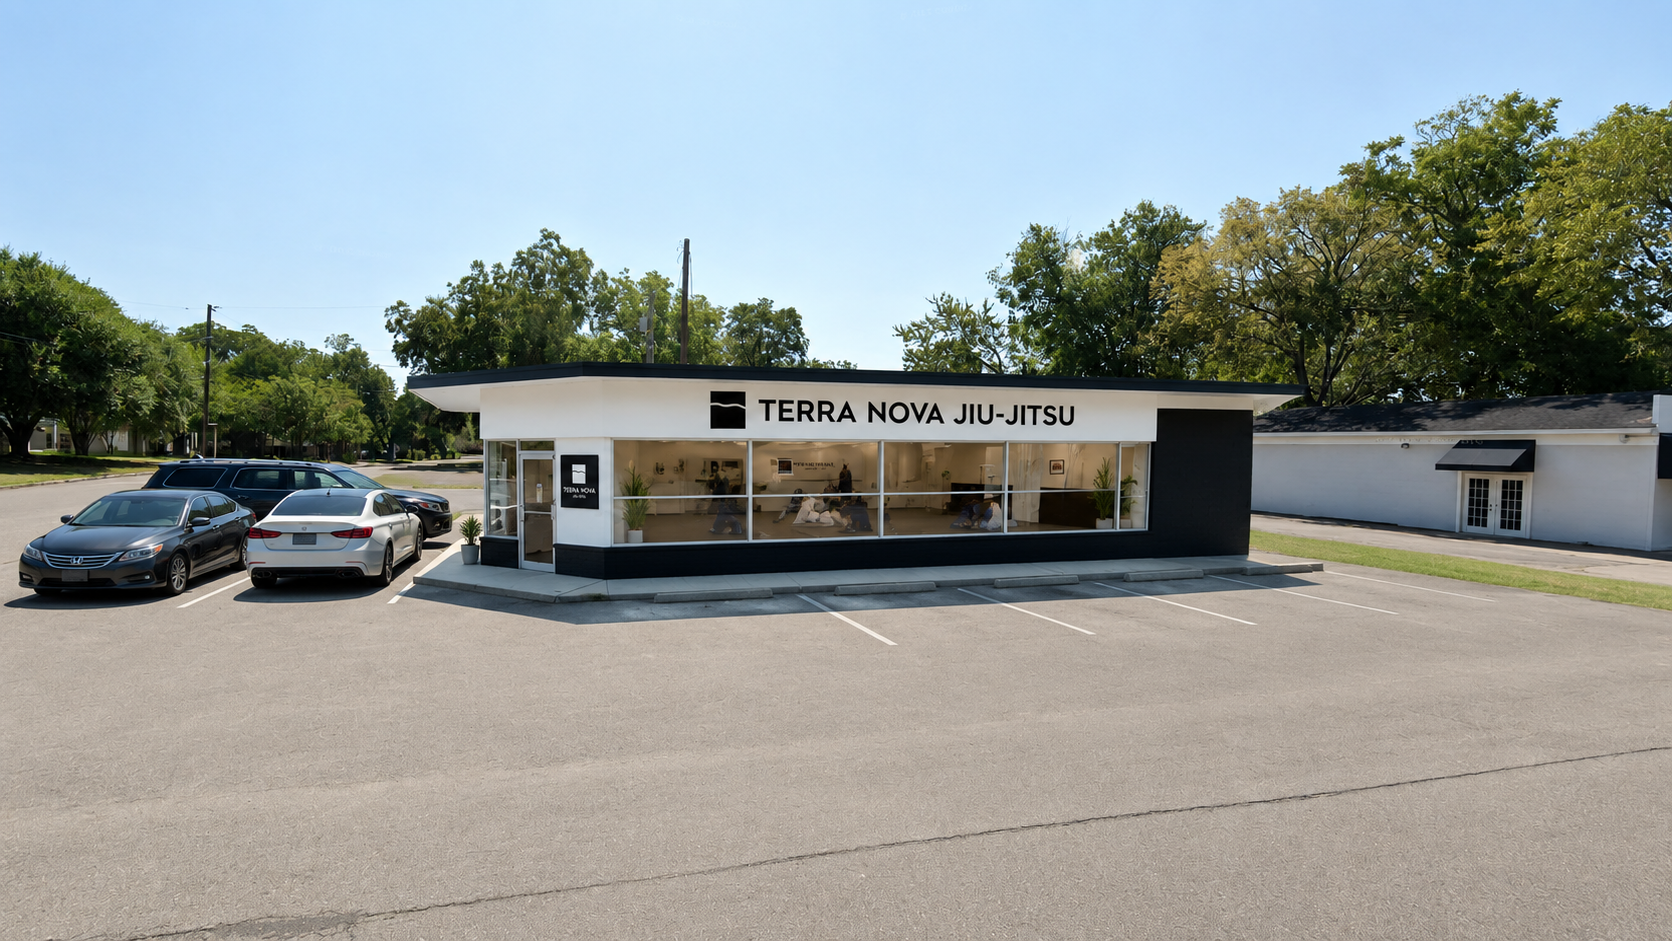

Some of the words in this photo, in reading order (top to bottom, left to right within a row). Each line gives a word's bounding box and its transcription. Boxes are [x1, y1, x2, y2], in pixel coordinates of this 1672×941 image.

[758, 398, 857, 423] TERRA
[867, 401, 945, 425] NOVA
[953, 403, 1075, 427] JIU-JITSU
